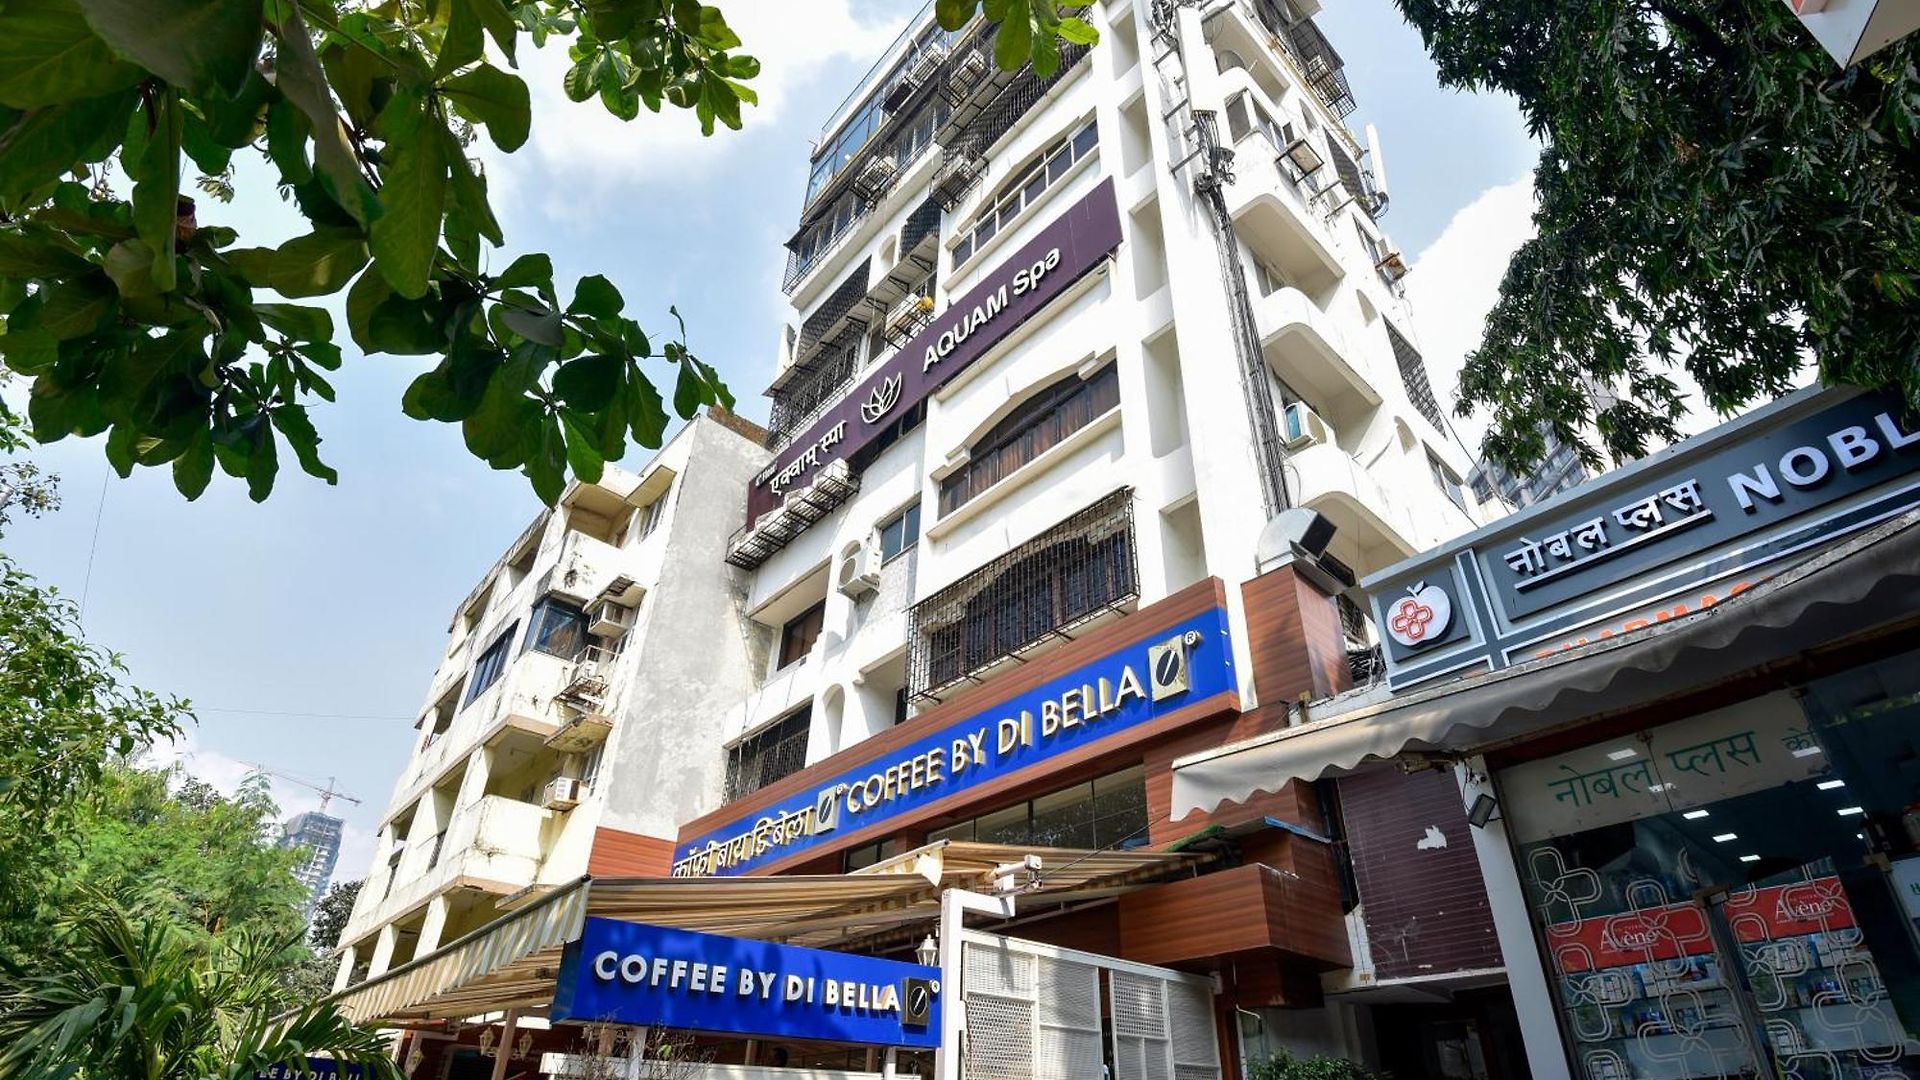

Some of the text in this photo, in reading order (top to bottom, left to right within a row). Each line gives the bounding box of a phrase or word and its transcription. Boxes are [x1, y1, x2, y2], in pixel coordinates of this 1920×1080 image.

[922, 248, 1060, 372] AQUAM Spa
[818, 420, 847, 453] स्पा
[1727, 412, 1920, 510] NOBL
[1503, 478, 1702, 573] नोबल प्लस
[846, 665, 1146, 814] COFFEE BY DI BELLA
[1548, 759, 1654, 806] नोबल
[1666, 730, 1761, 777] प्लस
[716, 833, 751, 867] बाय
[750, 817, 774, 856] डि
[772, 810, 815, 845] बेला
[594, 950, 902, 1012] COFFEE BY DI BELLA
